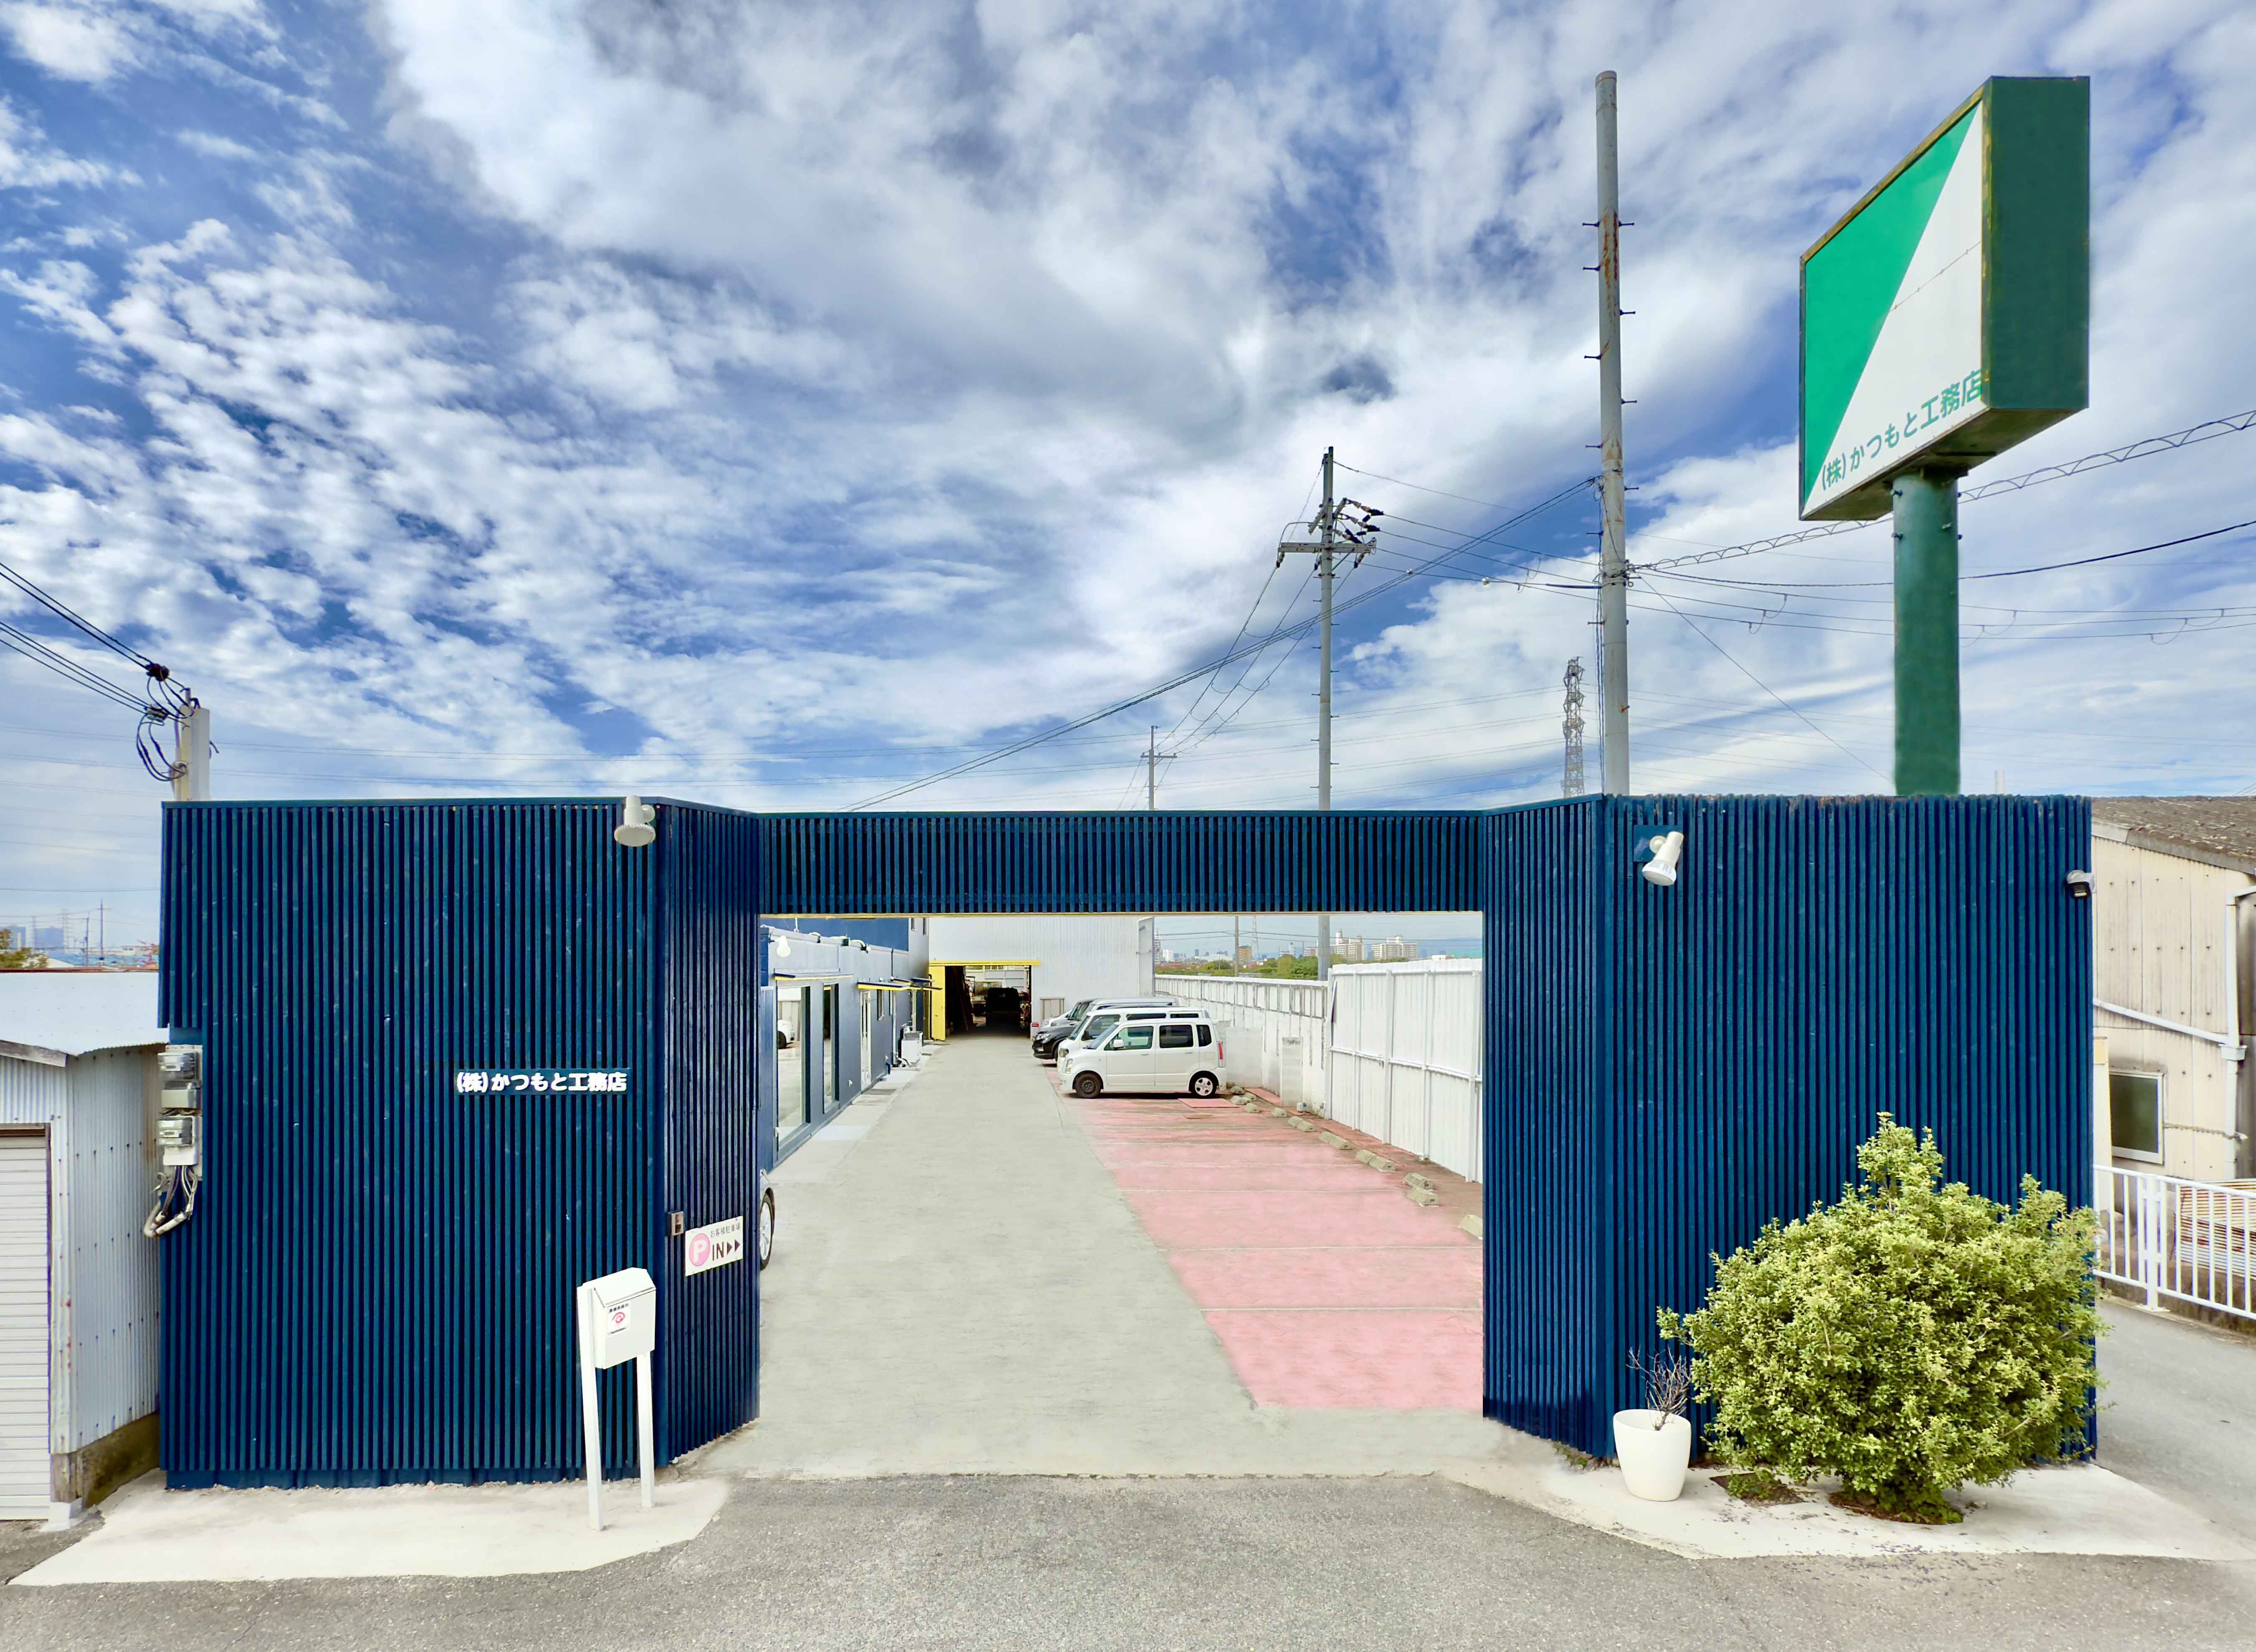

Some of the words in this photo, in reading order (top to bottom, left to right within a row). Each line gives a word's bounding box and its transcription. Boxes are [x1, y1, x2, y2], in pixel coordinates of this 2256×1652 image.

[1822, 369, 1982, 491] (株)かつもと工務店
[457, 1072, 627, 1093] (株)かつもと工務店
[693, 1240, 707, 1262] P
[712, 1241, 724, 1261] IN
